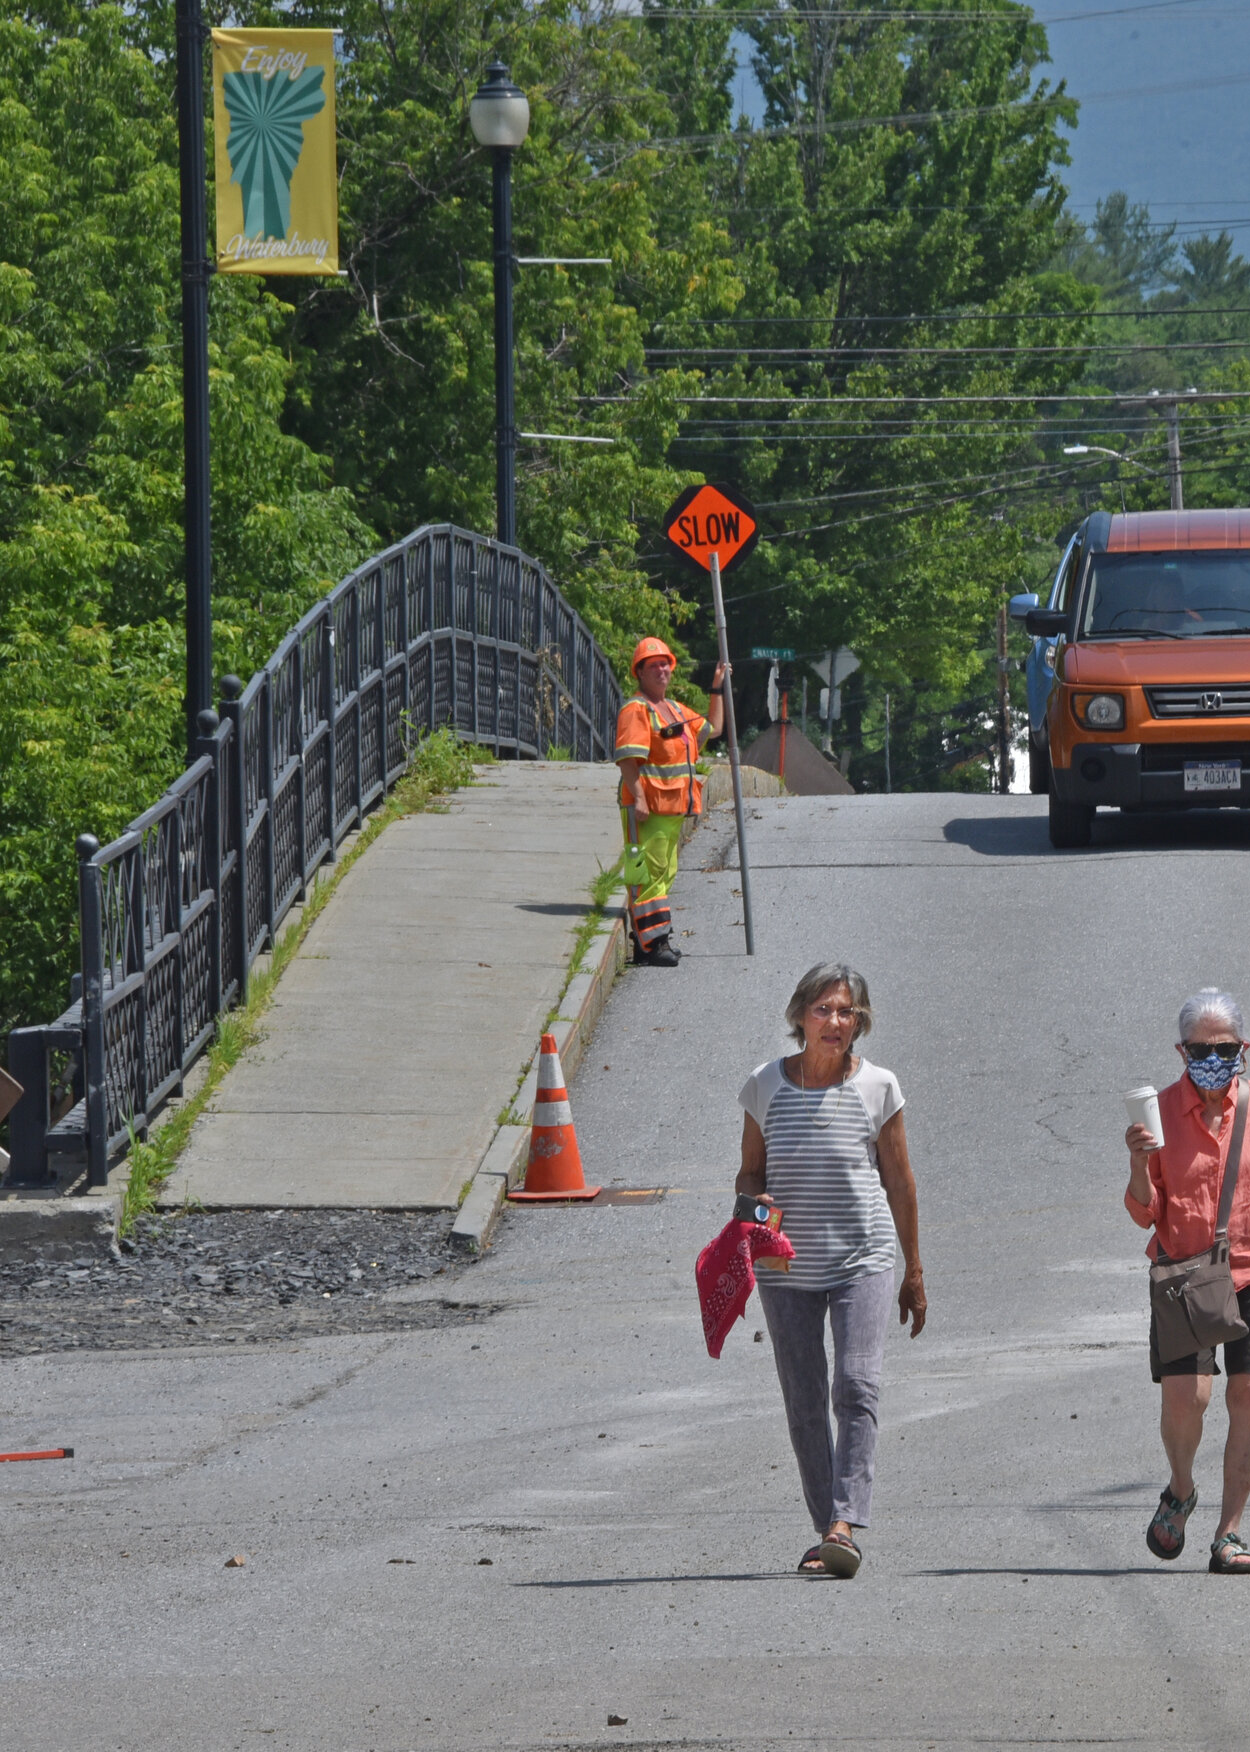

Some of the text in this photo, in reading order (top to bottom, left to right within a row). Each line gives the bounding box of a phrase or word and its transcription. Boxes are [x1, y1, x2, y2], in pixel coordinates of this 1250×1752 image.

[241, 45, 308, 81] Enjoy
[226, 231, 329, 265] Waterbury
[678, 511, 739, 548] SLOW
